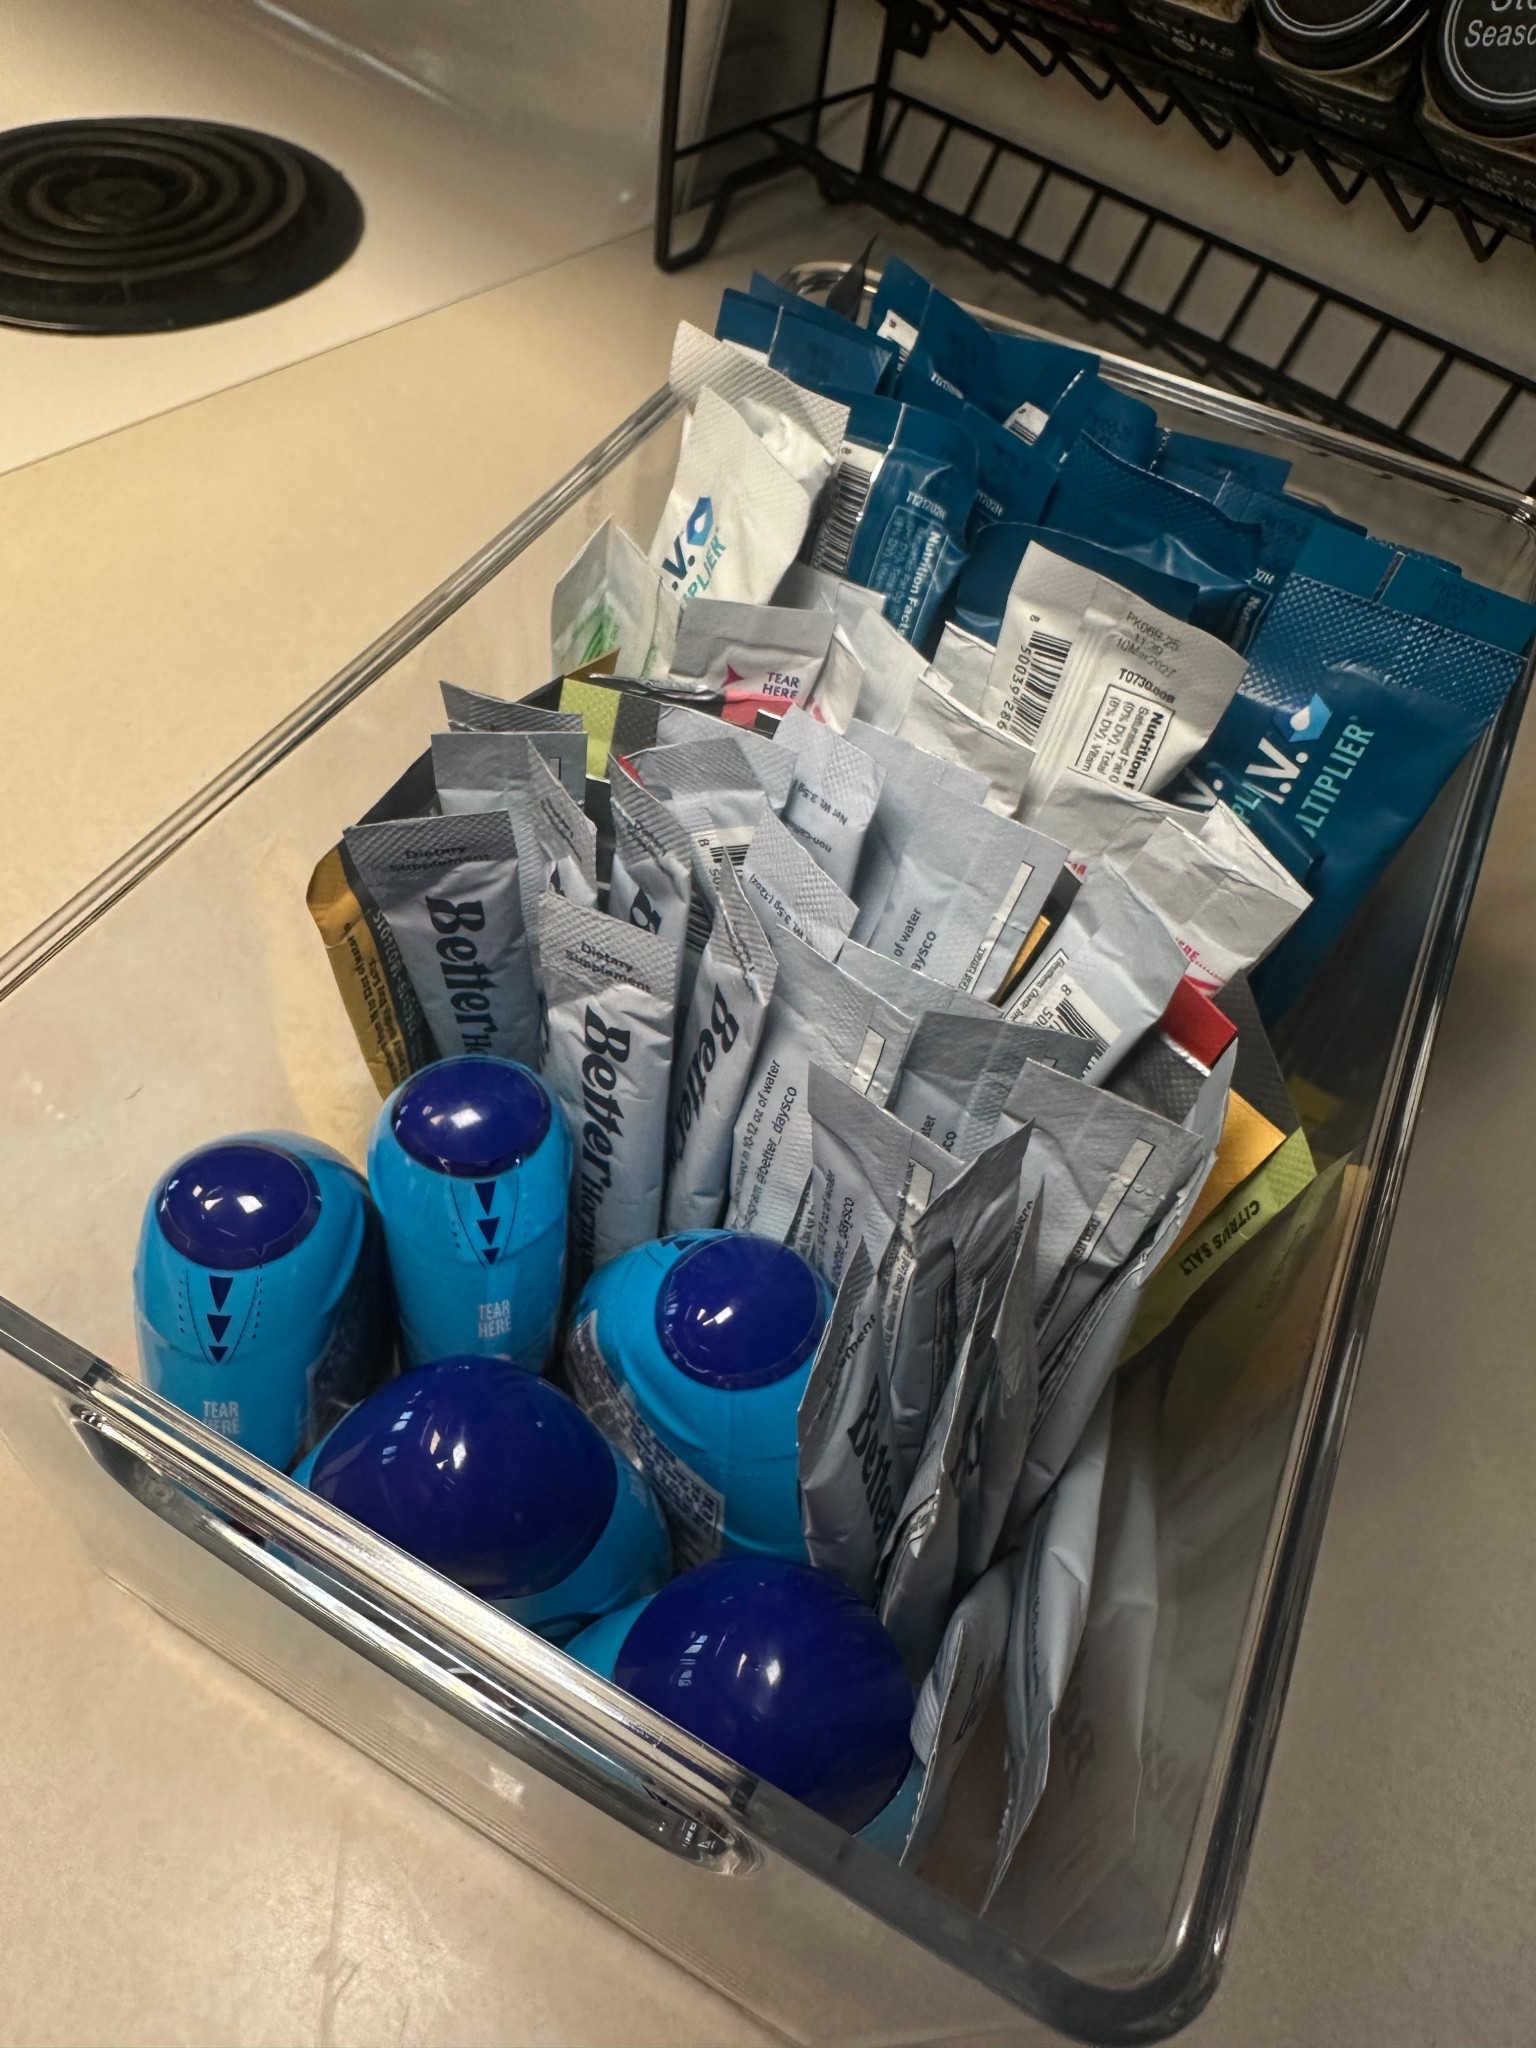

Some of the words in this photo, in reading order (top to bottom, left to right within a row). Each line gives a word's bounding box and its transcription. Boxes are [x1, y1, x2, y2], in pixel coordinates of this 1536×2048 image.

[910, 530, 942, 596] Nutrition
[767, 671, 800, 689] TEAR
[1009, 644, 1032, 697] 50039
[762, 683, 799, 700] HERE
[1120, 706, 1149, 756] Saturated
[1124, 711, 1166, 781] Nutrition
[1112, 756, 1127, 775] Fat
[890, 941, 906, 958] of
[898, 908, 923, 944] water
[580, 942, 634, 973] Dietary
[1059, 983, 1073, 997] 8
[760, 1059, 781, 1093] water
[754, 1092, 771, 1108] of
[752, 1109, 765, 1124] oz
[1209, 1199, 1263, 1250] CITRUS
[1176, 1240, 1215, 1277] SALT
[478, 1300, 511, 1322] TEAR
[478, 1315, 512, 1338] HERE
[202, 1400, 239, 1419] TEAR
